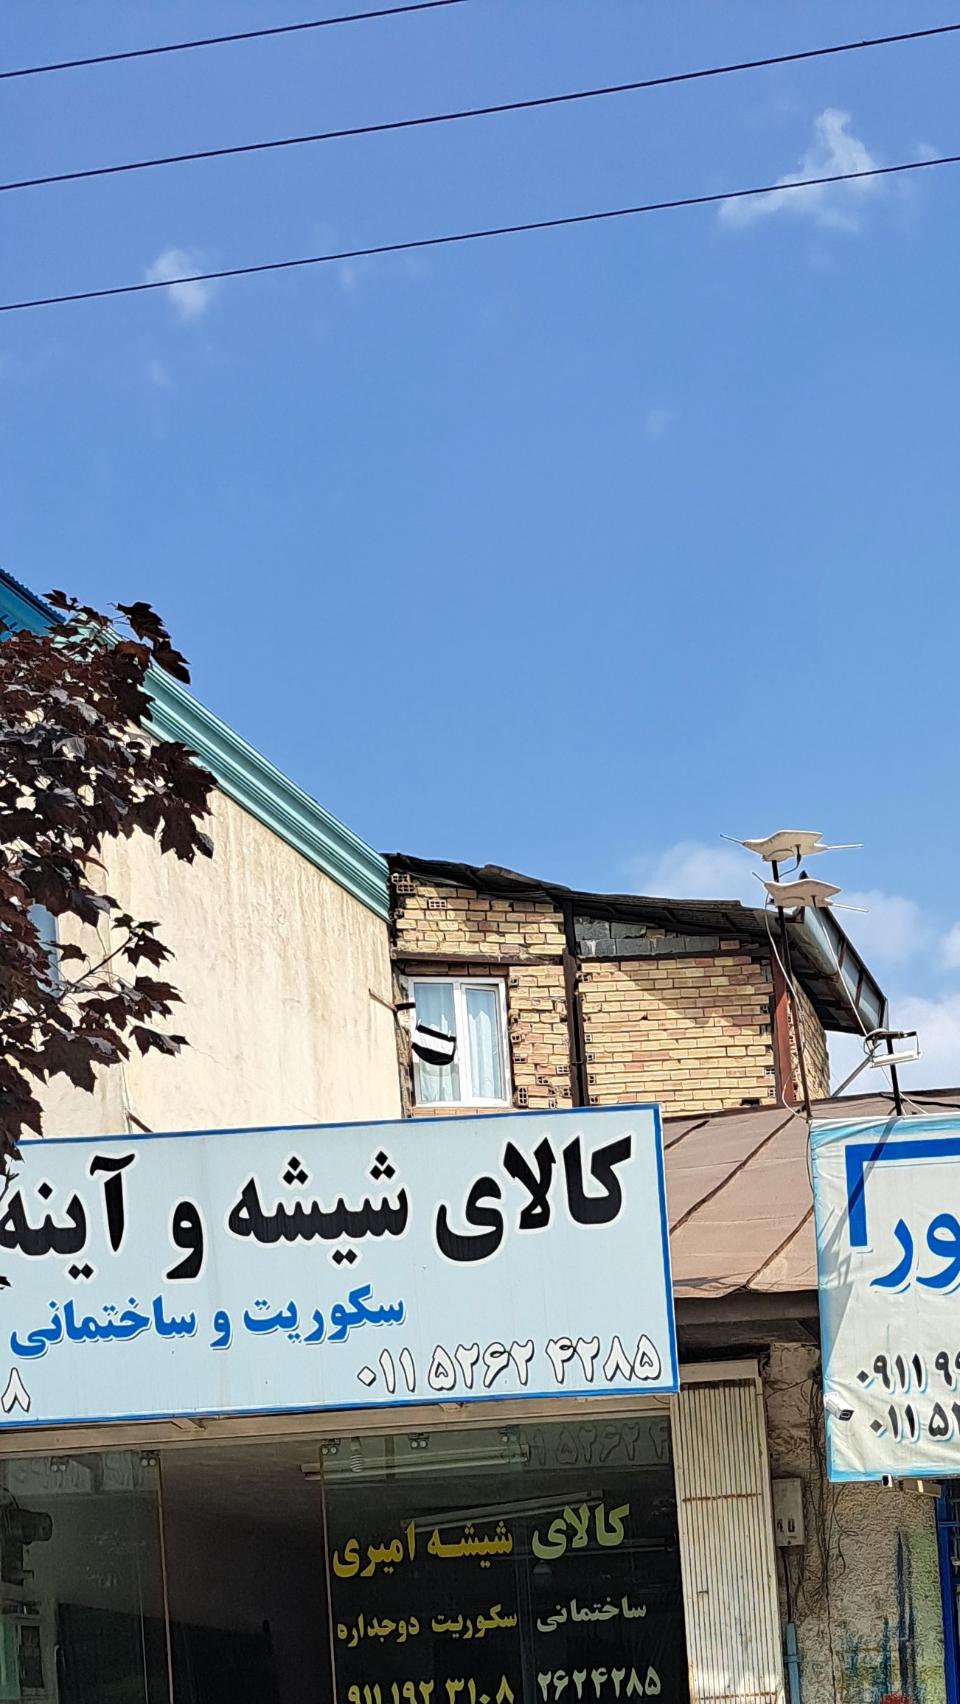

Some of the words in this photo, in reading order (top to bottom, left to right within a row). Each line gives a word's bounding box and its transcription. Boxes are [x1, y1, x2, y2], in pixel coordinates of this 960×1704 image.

[228, 1150, 408, 1264] شیشه
[436, 1135, 632, 1262] کالای
[166, 1201, 204, 1279] و
[10, 1296, 196, 1357] ساختمانی
[210, 1311, 231, 1348] و
[243, 1284, 403, 1342] سکوریت
[357, 1347, 416, 1394] ۰۱۱
[428, 1339, 535, 1390] ۵۲۶۲
[546, 1334, 662, 1383] ۴۲۸۵
[856, 1353, 924, 1391] ۰۹۱۱
[870, 1402, 917, 1440] ۰۱۱
[333, 1520, 416, 1578] امیری
[427, 1520, 514, 1568] شیشه
[531, 1503, 630, 1559] کالای
[336, 1613, 421, 1648] دوجداره
[431, 1604, 519, 1639] سکوریت
[537, 1596, 647, 1632] ساختمانی
[537, 1665, 662, 1703] ۲۶۲۴۲۸۵
